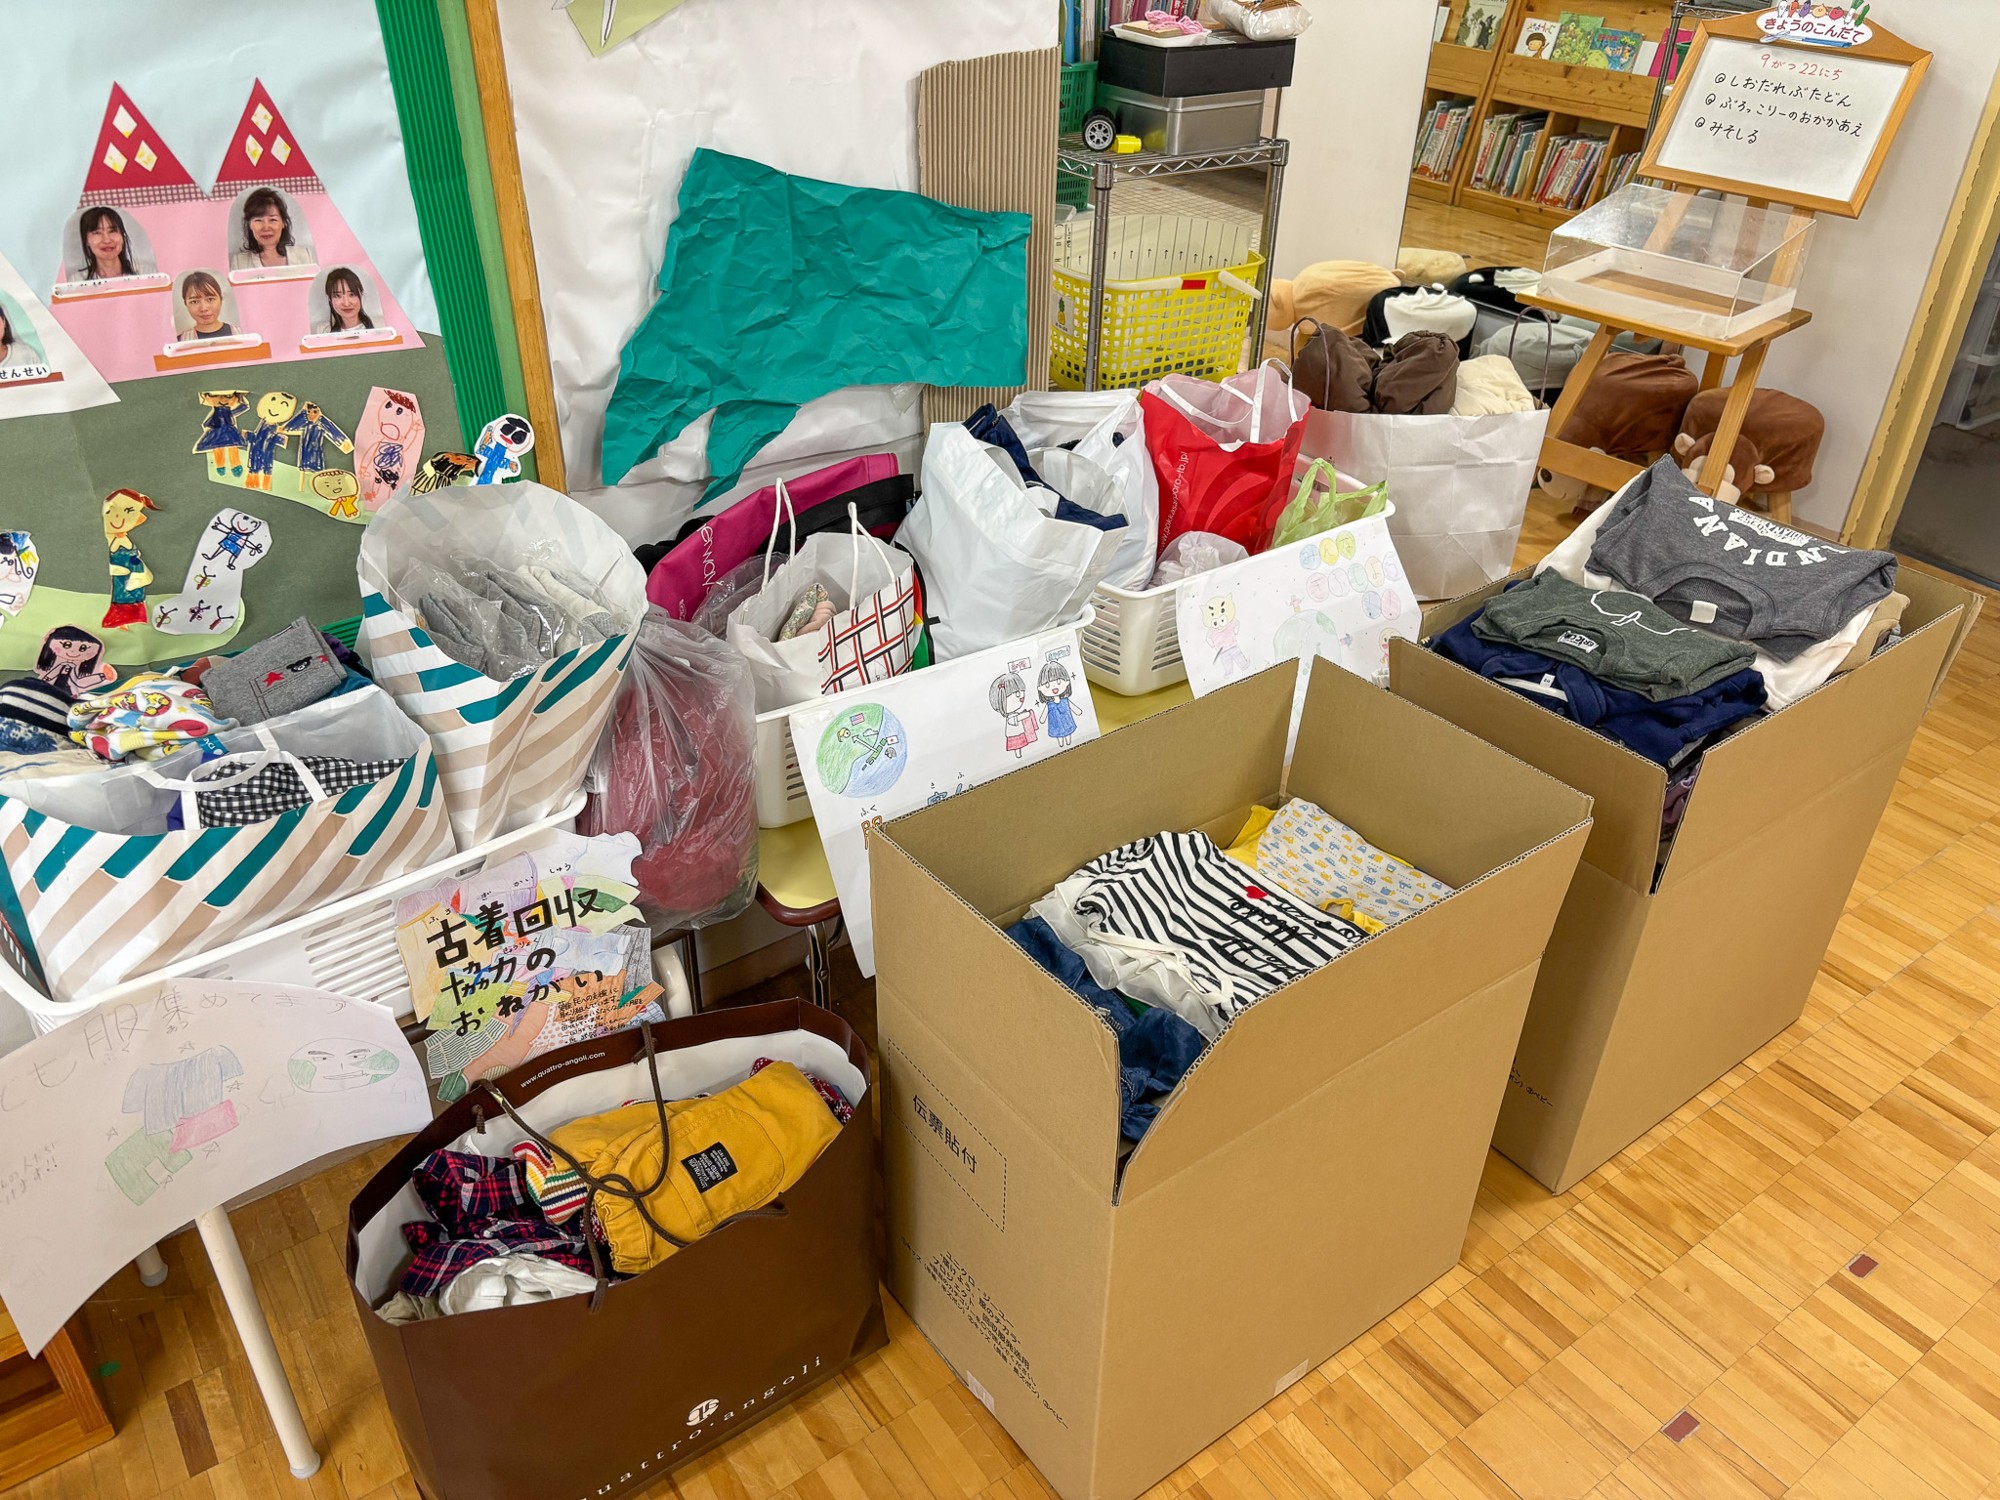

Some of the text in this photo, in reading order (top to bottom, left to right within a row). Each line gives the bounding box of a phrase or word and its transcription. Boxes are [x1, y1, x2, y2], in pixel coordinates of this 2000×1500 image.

[1763, 17, 1865, 44] きょうのこんだて
[0, 365, 48, 380] せんせい
[1688, 496, 1850, 566] NDIANA
[426, 888, 604, 969] 古着回収
[440, 947, 556, 1006] 協力の
[451, 969, 603, 1037] おねがい
[520, 1051, 606, 1088] www.quattro-angoli.com
[912, 1094, 978, 1175] 伝票貼付
